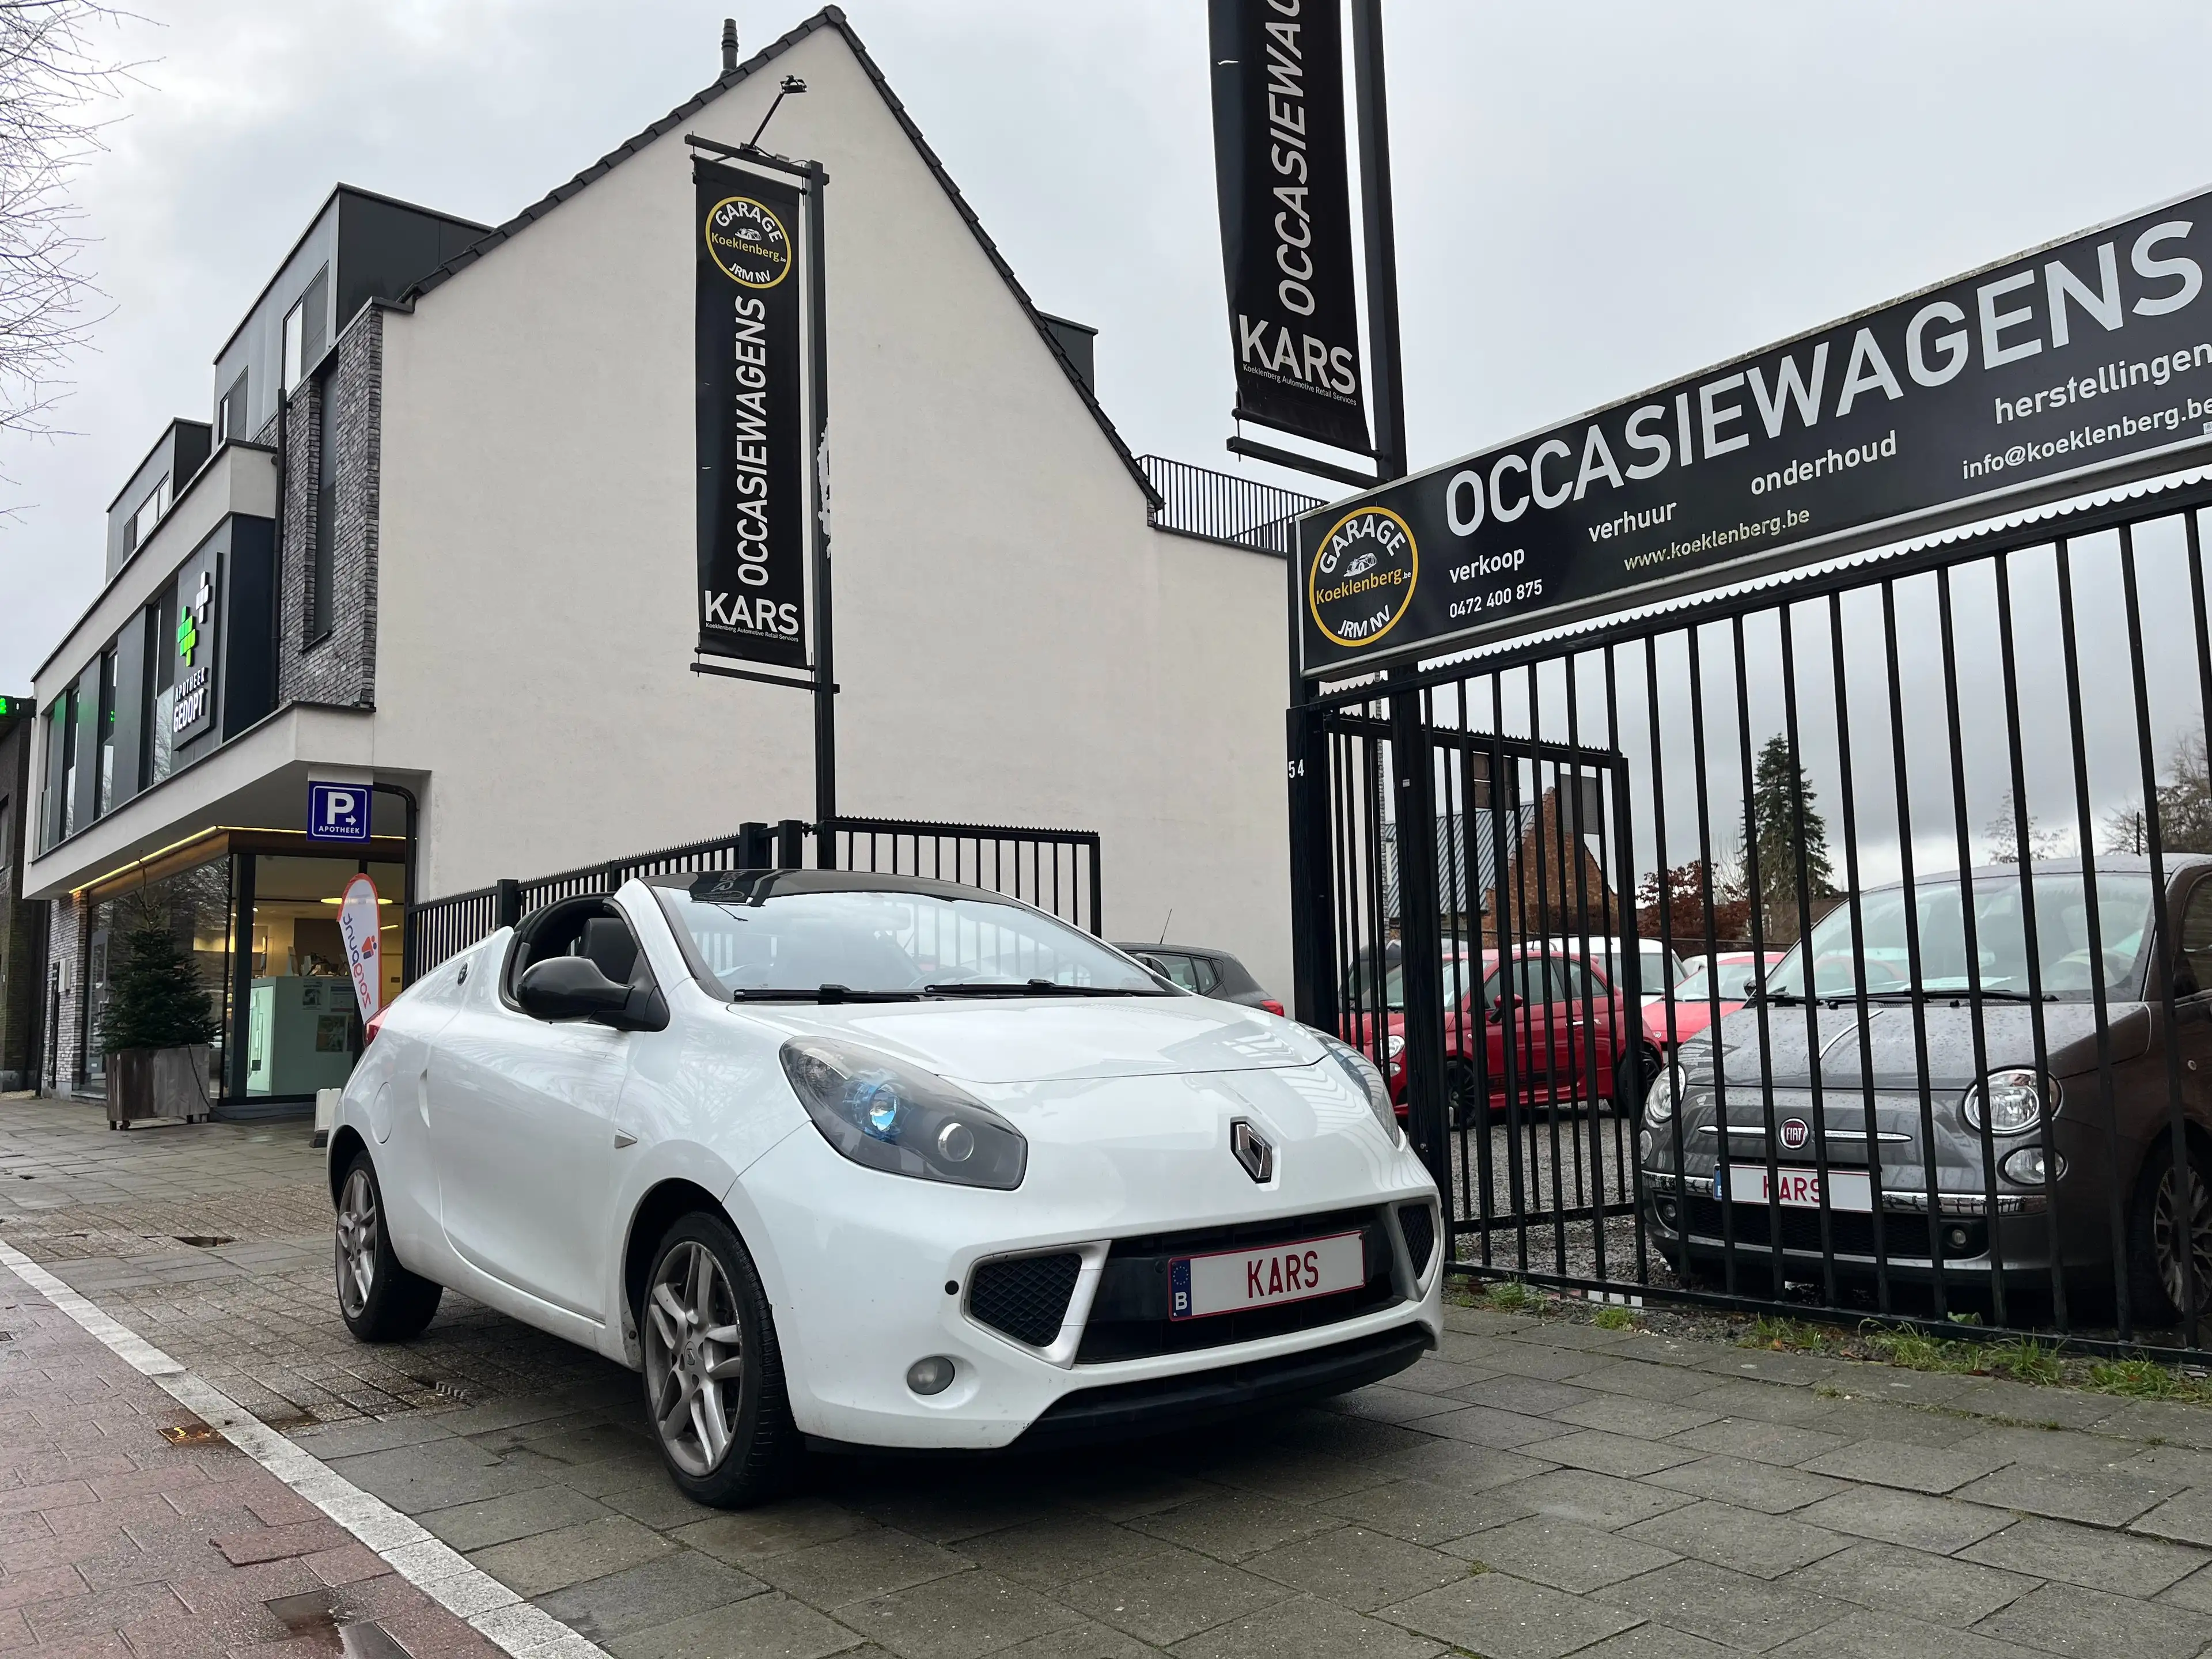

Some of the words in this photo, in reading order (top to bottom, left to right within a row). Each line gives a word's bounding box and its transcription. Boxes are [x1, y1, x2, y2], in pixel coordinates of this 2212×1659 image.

[715, 201, 783, 243] GARAGE
[729, 263, 753, 282] JRM
[755, 269, 771, 283] NV
[1238, 314, 1355, 395] KARS
[1243, 363, 1281, 384] Koeklenberg
[1282, 375, 1315, 393] Automotive
[1315, 385, 1332, 398] Retail
[1332, 392, 1357, 406] Services
[1446, 220, 2203, 537] OCCASIEWAGENS
[1994, 343, 2212, 425] herstellingen
[734, 295, 768, 586] OCCASIEWAGENS
[1963, 397, 2212, 479] info@koeklenberg.be
[1750, 429, 1897, 495] onderhoud
[1588, 501, 1677, 543] verhuur
[1623, 507, 1810, 571] www.koeklenberg.be
[1320, 514, 1406, 574] GARAGE
[1316, 568, 1412, 605] Koeklenberg.be
[1449, 548, 1525, 584] verkoop
[704, 589, 800, 635] KARS
[1449, 596, 1482, 618] 0472
[1486, 588, 1512, 608] 400
[1516, 578, 1543, 600] 875
[705, 622, 737, 633] Koeklenberg
[737, 627, 764, 637] Automotive
[778, 634, 799, 642] Services
[1337, 619, 1368, 638] JRM
[1369, 604, 1391, 632] NV
[175, 666, 205, 702] APOTHEEK
[173, 687, 204, 733] GEDOPT
[1288, 759, 1305, 778] 54
[327, 791, 355, 825] P
[318, 825, 360, 834] APOTHEEK
[1786, 1127, 1803, 1141] FIAT
[1247, 1250, 1319, 1299] KARS
[1175, 1291, 1188, 1311] B
